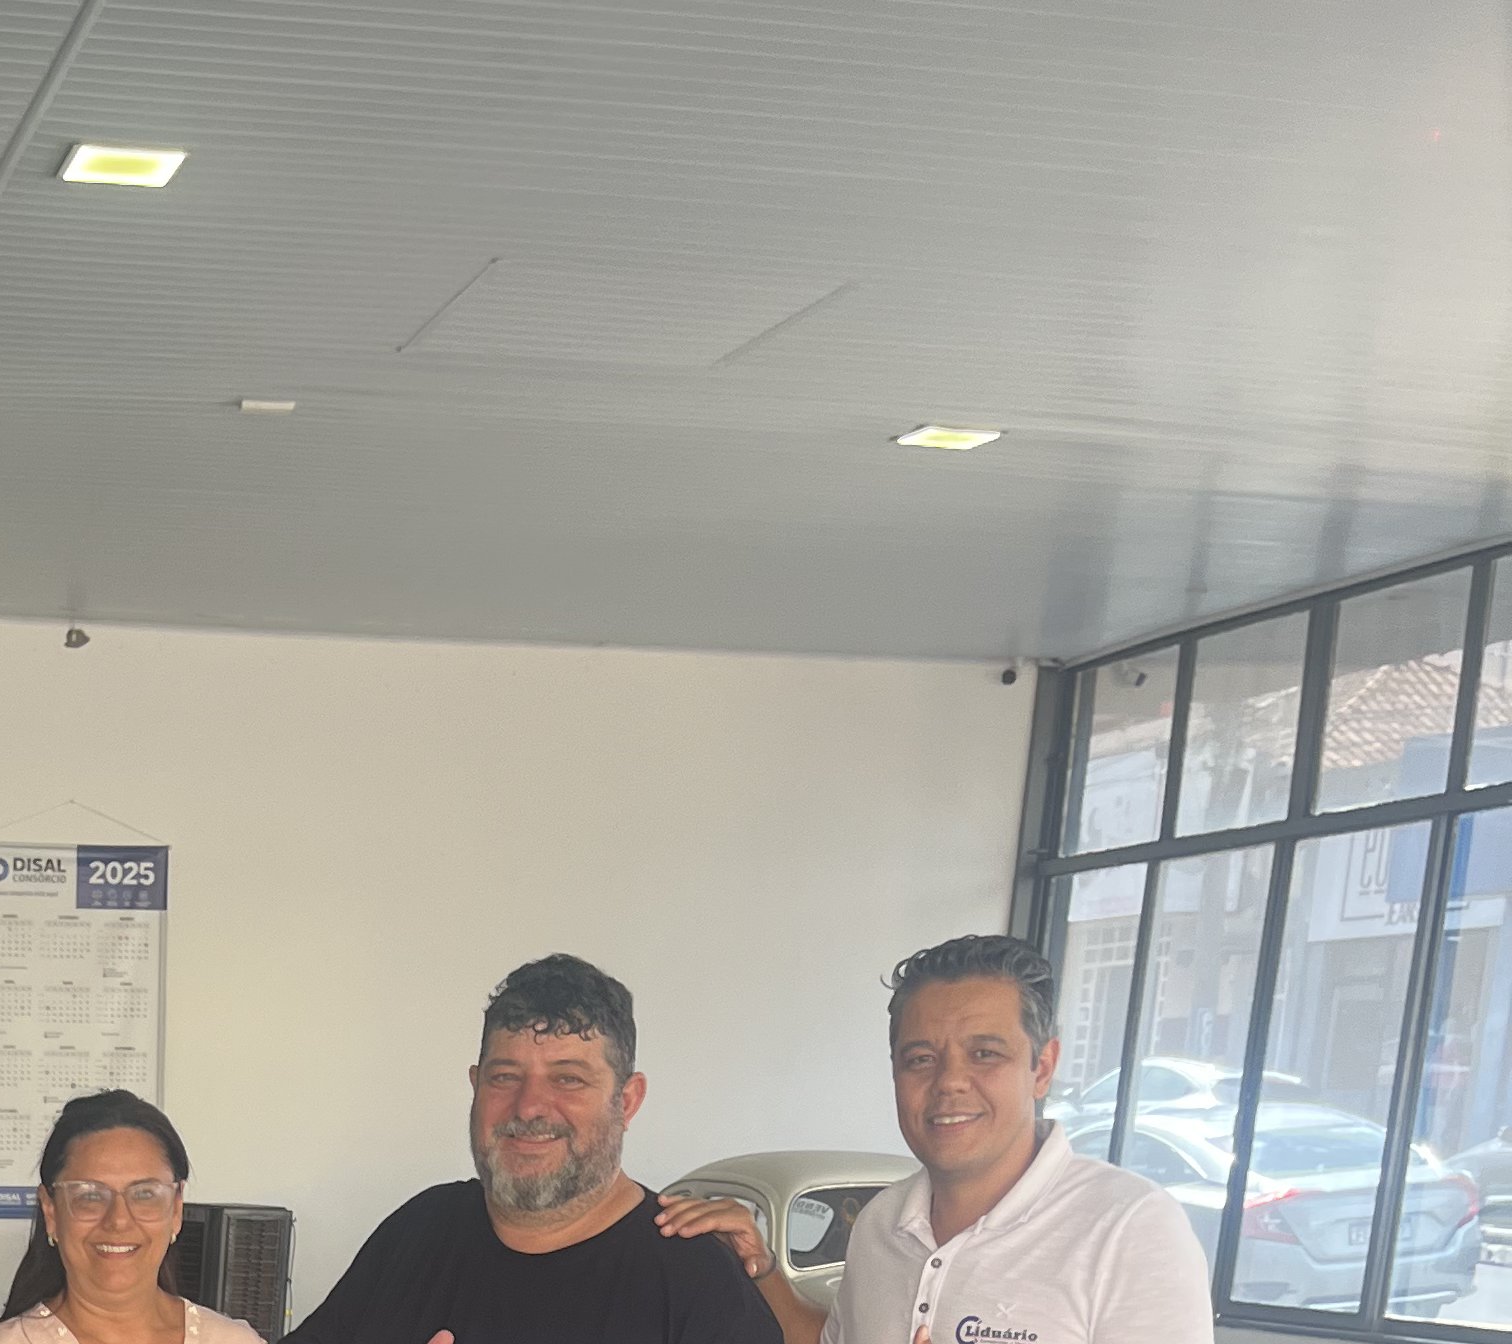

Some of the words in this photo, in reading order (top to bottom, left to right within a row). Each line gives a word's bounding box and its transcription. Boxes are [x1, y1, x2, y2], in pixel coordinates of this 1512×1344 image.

[13, 857, 67, 872] DISAL
[12, 873, 67, 884] CONSÓRCIO
[88, 861, 155, 885] 2025
[965, 1325, 1038, 1343] Liduário
